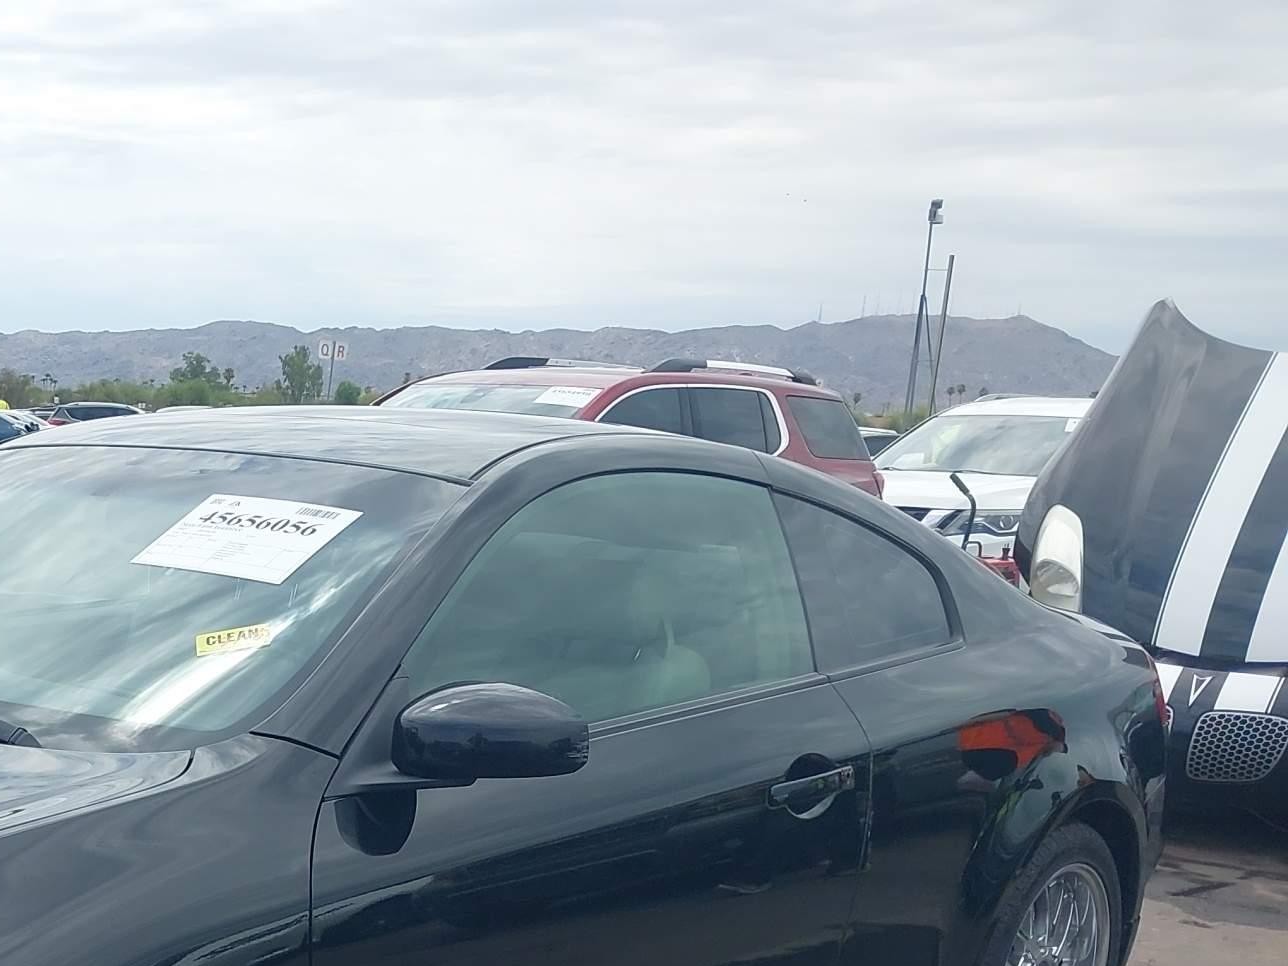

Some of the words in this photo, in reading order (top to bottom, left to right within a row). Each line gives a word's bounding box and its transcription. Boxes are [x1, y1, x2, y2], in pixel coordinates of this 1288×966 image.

[321, 343, 330, 357] Q
[337, 345, 345, 358] R
[199, 511, 326, 537] 45656056
